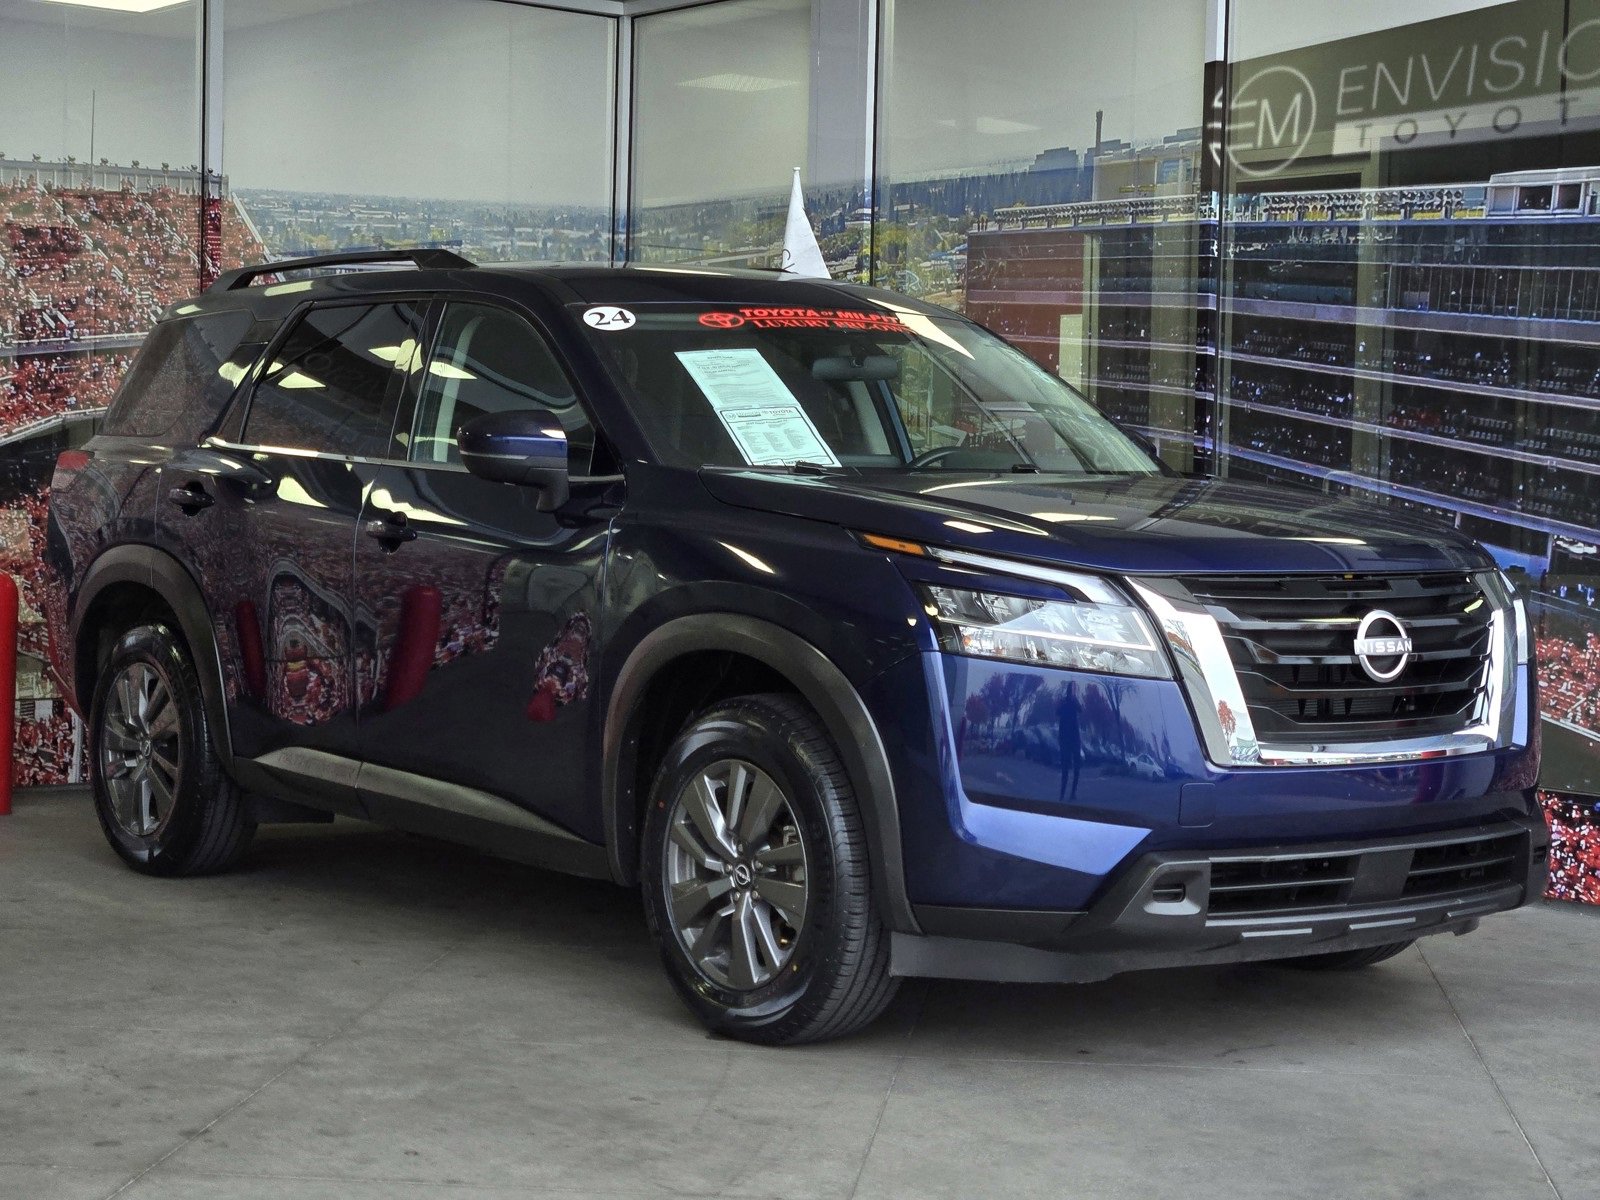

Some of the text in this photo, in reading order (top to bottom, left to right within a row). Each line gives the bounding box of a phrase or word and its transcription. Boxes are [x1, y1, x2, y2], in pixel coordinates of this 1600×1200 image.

[588, 310, 631, 326] 24
[739, 308, 821, 318] TOYOTA
[752, 320, 830, 329] LUXURY
[1356, 640, 1412, 653] NISSAN
